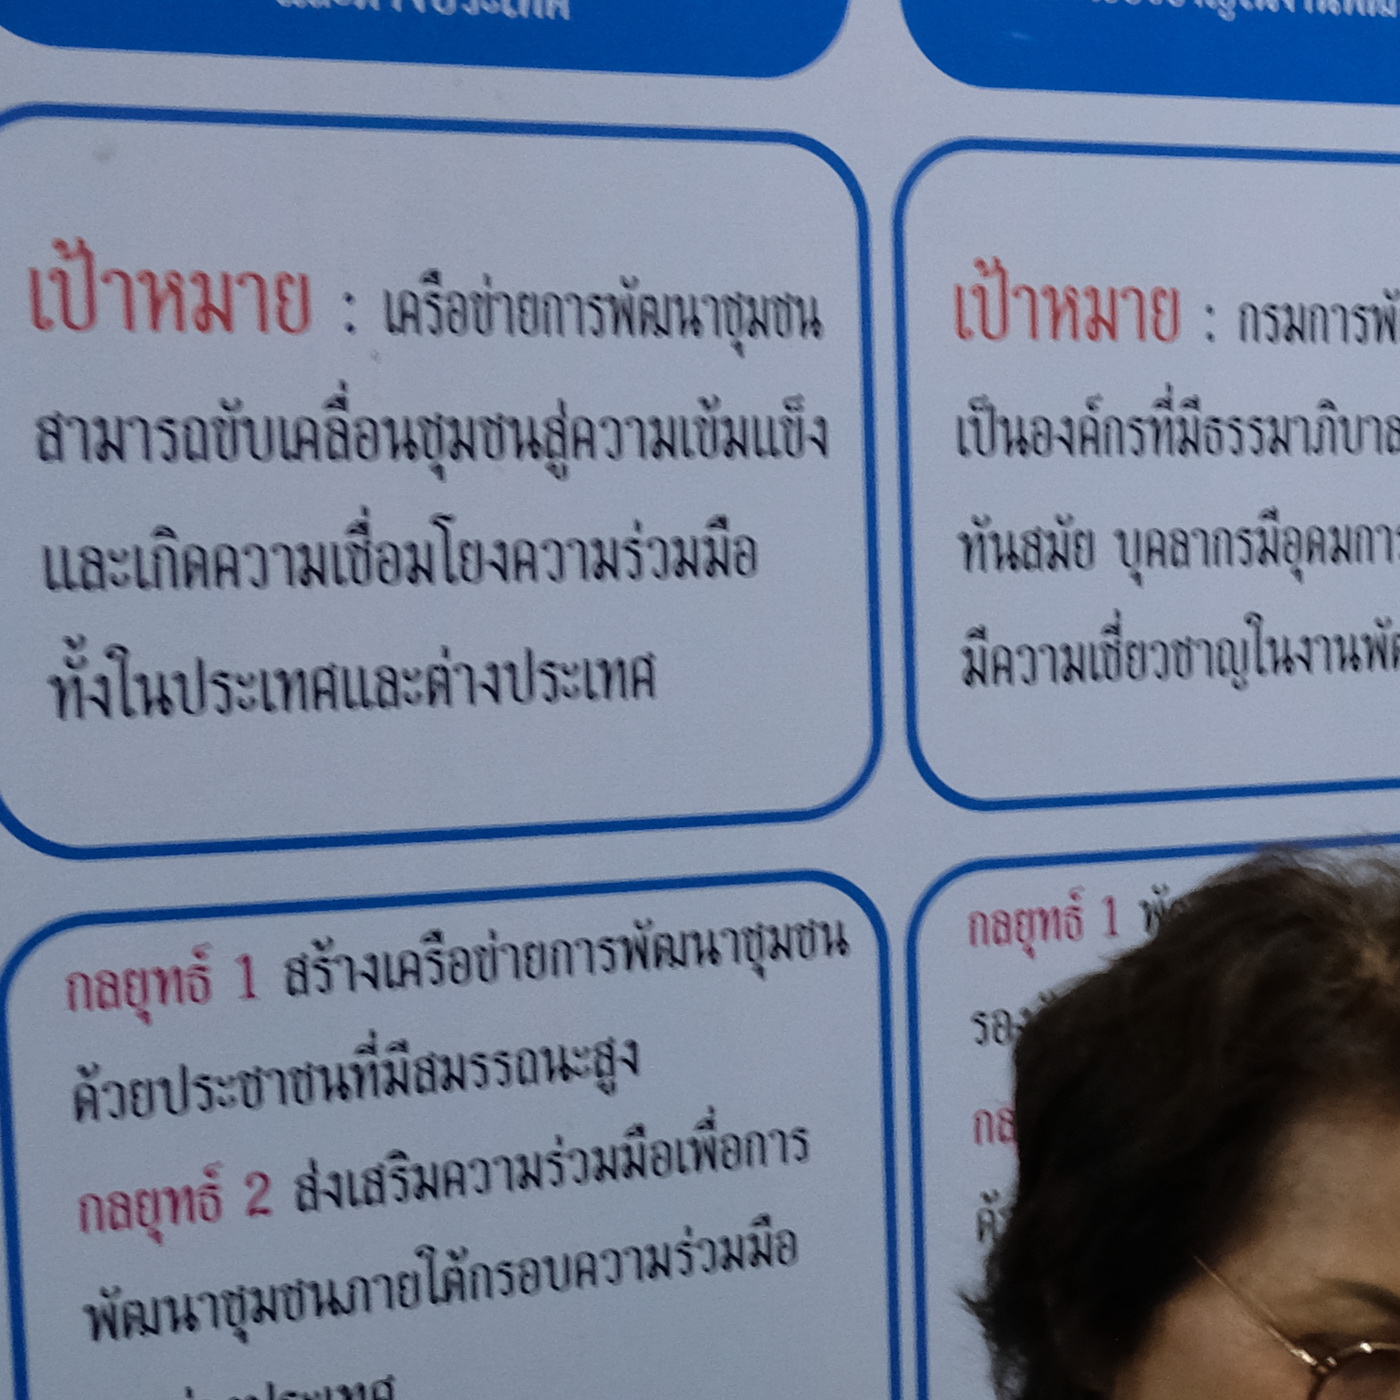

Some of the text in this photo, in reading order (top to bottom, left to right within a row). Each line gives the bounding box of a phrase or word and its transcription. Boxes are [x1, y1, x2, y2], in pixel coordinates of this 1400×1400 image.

[28, 235, 313, 337] เป้าหมาย
[382, 267, 825, 359] เครือข่ายการพัฒนาชุมชน
[953, 255, 1182, 344] เป้าหมาย
[34, 378, 830, 484] สามารถขับเคลื่อนชุมชนสู่ความเข้มแข็ง
[41, 504, 759, 594] และเกิดความเชื่อมโยงความร่วมมือ
[956, 512, 1096, 574] ทันสมัย
[46, 633, 657, 722] ทั้งในประเทศและต่างประเทศ
[967, 885, 1085, 960] กลยุทธ์
[1102, 894, 1119, 938] 1
[64, 915, 851, 1027] กลยุทธ์ 1 สร้างเครือข่ายการพัฒนาชุมชน
[72, 1030, 641, 1125] ด้วยประชาชนที่มีสมรรถนะสูง
[78, 1106, 811, 1248] กลยุทธ์ 2 ส่งเสริมความร่วมมือเพื่อการ
[82, 1213, 799, 1345] พัฒนาชุมชนภายใต้กรอบความร่วมมือ
